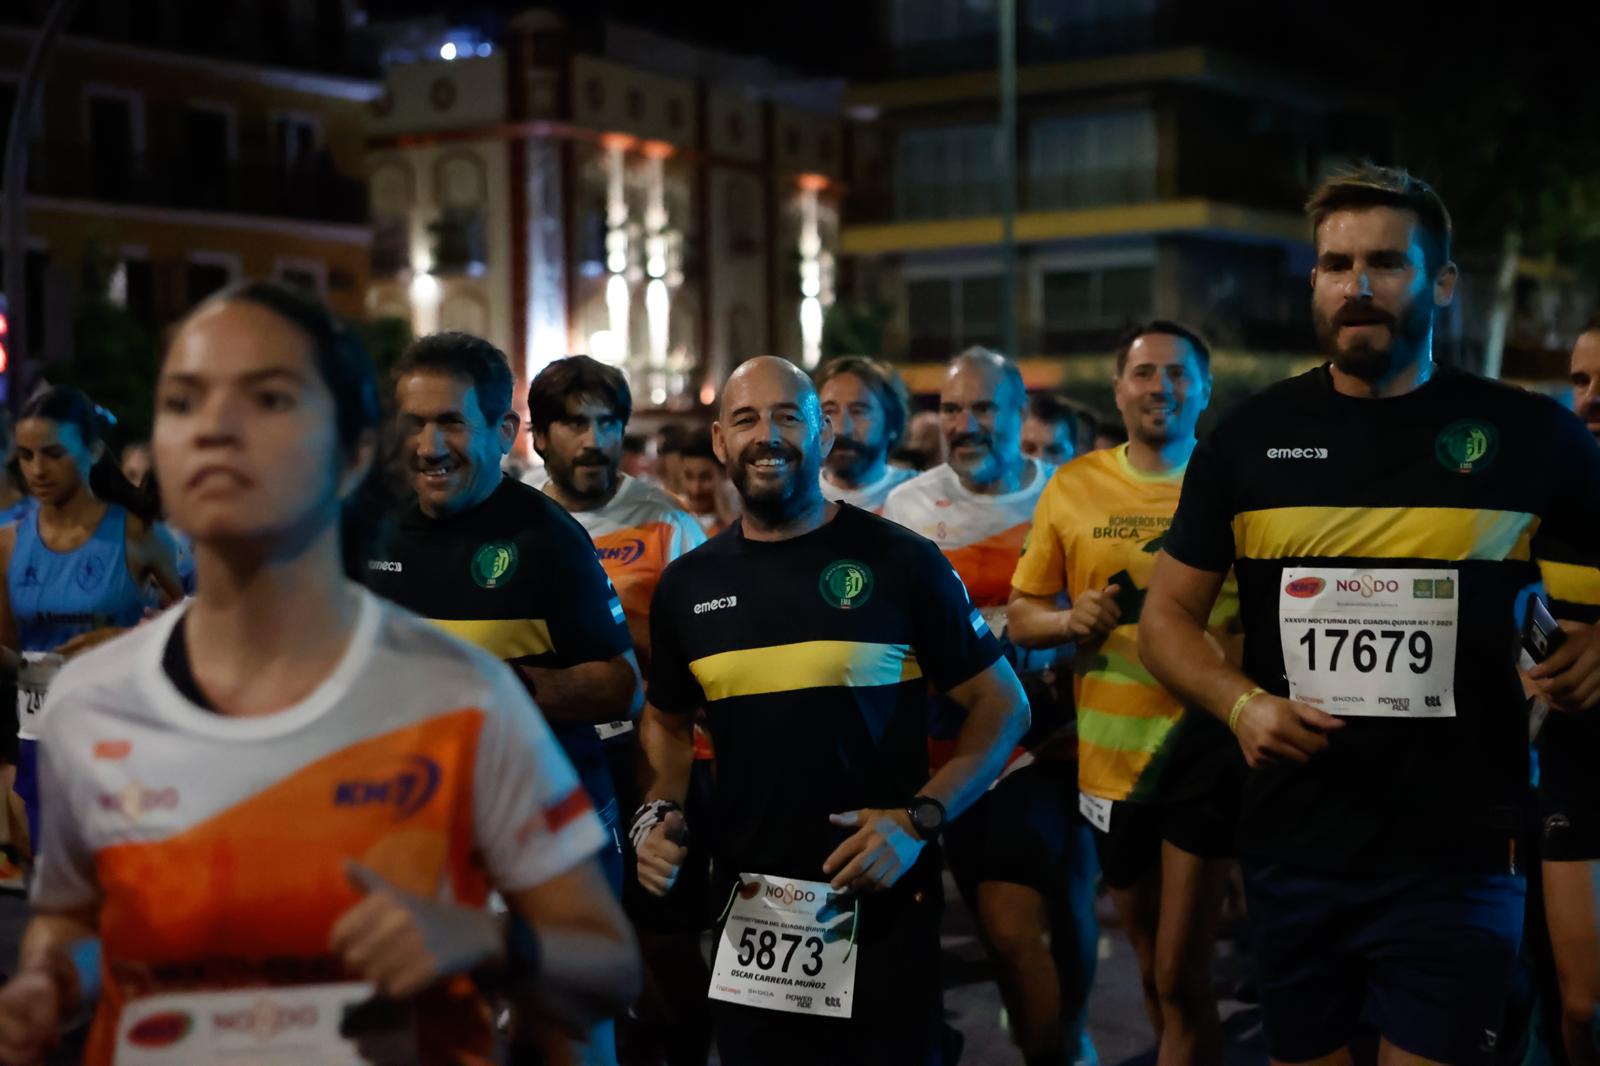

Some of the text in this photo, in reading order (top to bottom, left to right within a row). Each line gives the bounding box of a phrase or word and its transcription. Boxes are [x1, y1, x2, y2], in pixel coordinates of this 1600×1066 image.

[1363, 619, 1417, 627] GUADALQUIVIR
[1300, 628, 1433, 674] 17679
[1378, 697, 1410, 706] POWER
[737, 927, 824, 976] 5873
[731, 968, 826, 990] OSCAR CARRERA MUÑOZ
